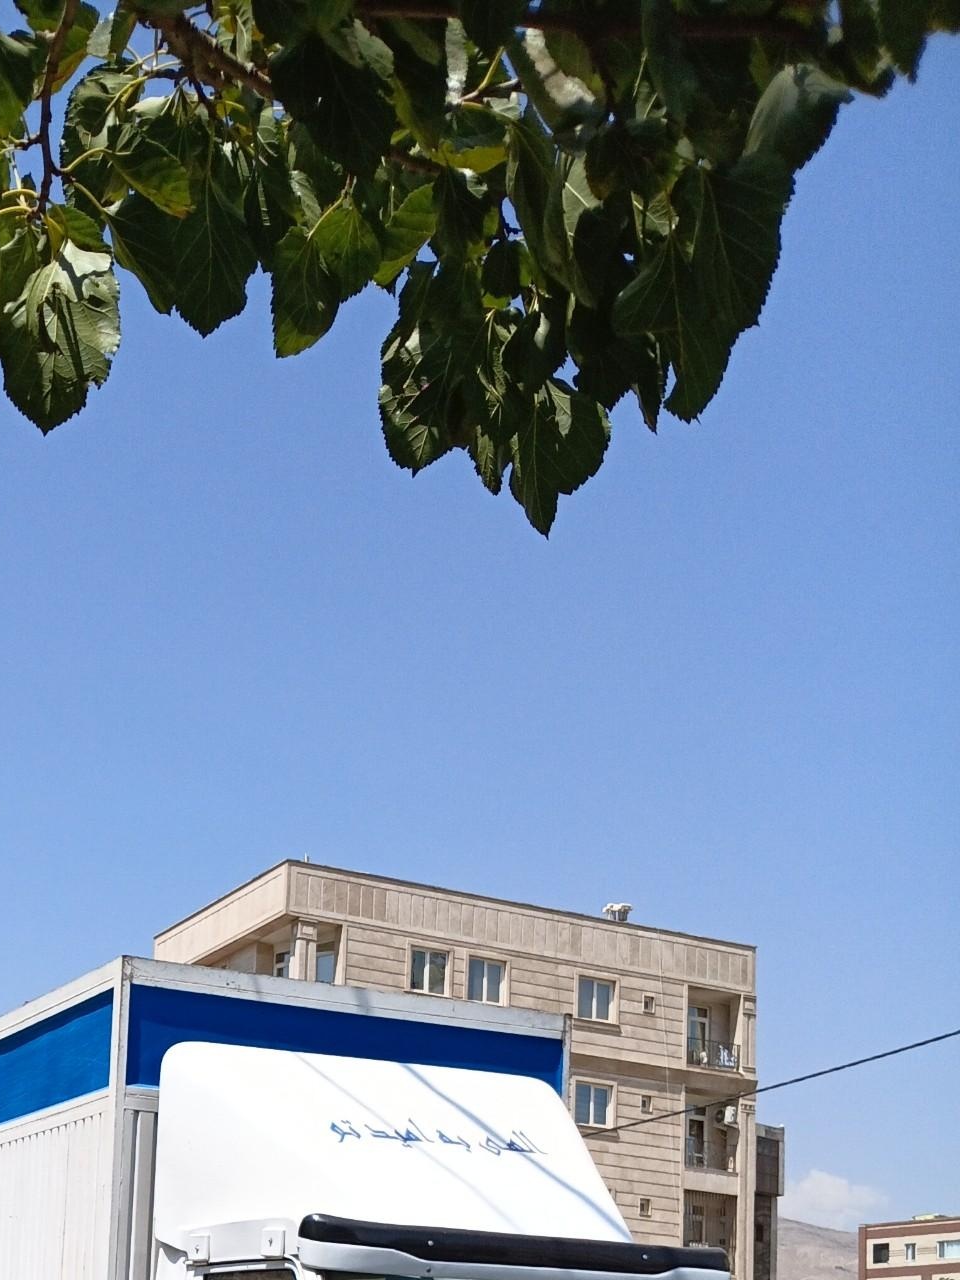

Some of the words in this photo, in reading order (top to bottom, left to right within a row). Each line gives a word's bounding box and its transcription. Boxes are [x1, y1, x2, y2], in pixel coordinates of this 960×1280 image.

[329, 1119, 361, 1143] تو
[364, 1117, 434, 1148] امید
[436, 1129, 471, 1152] به
